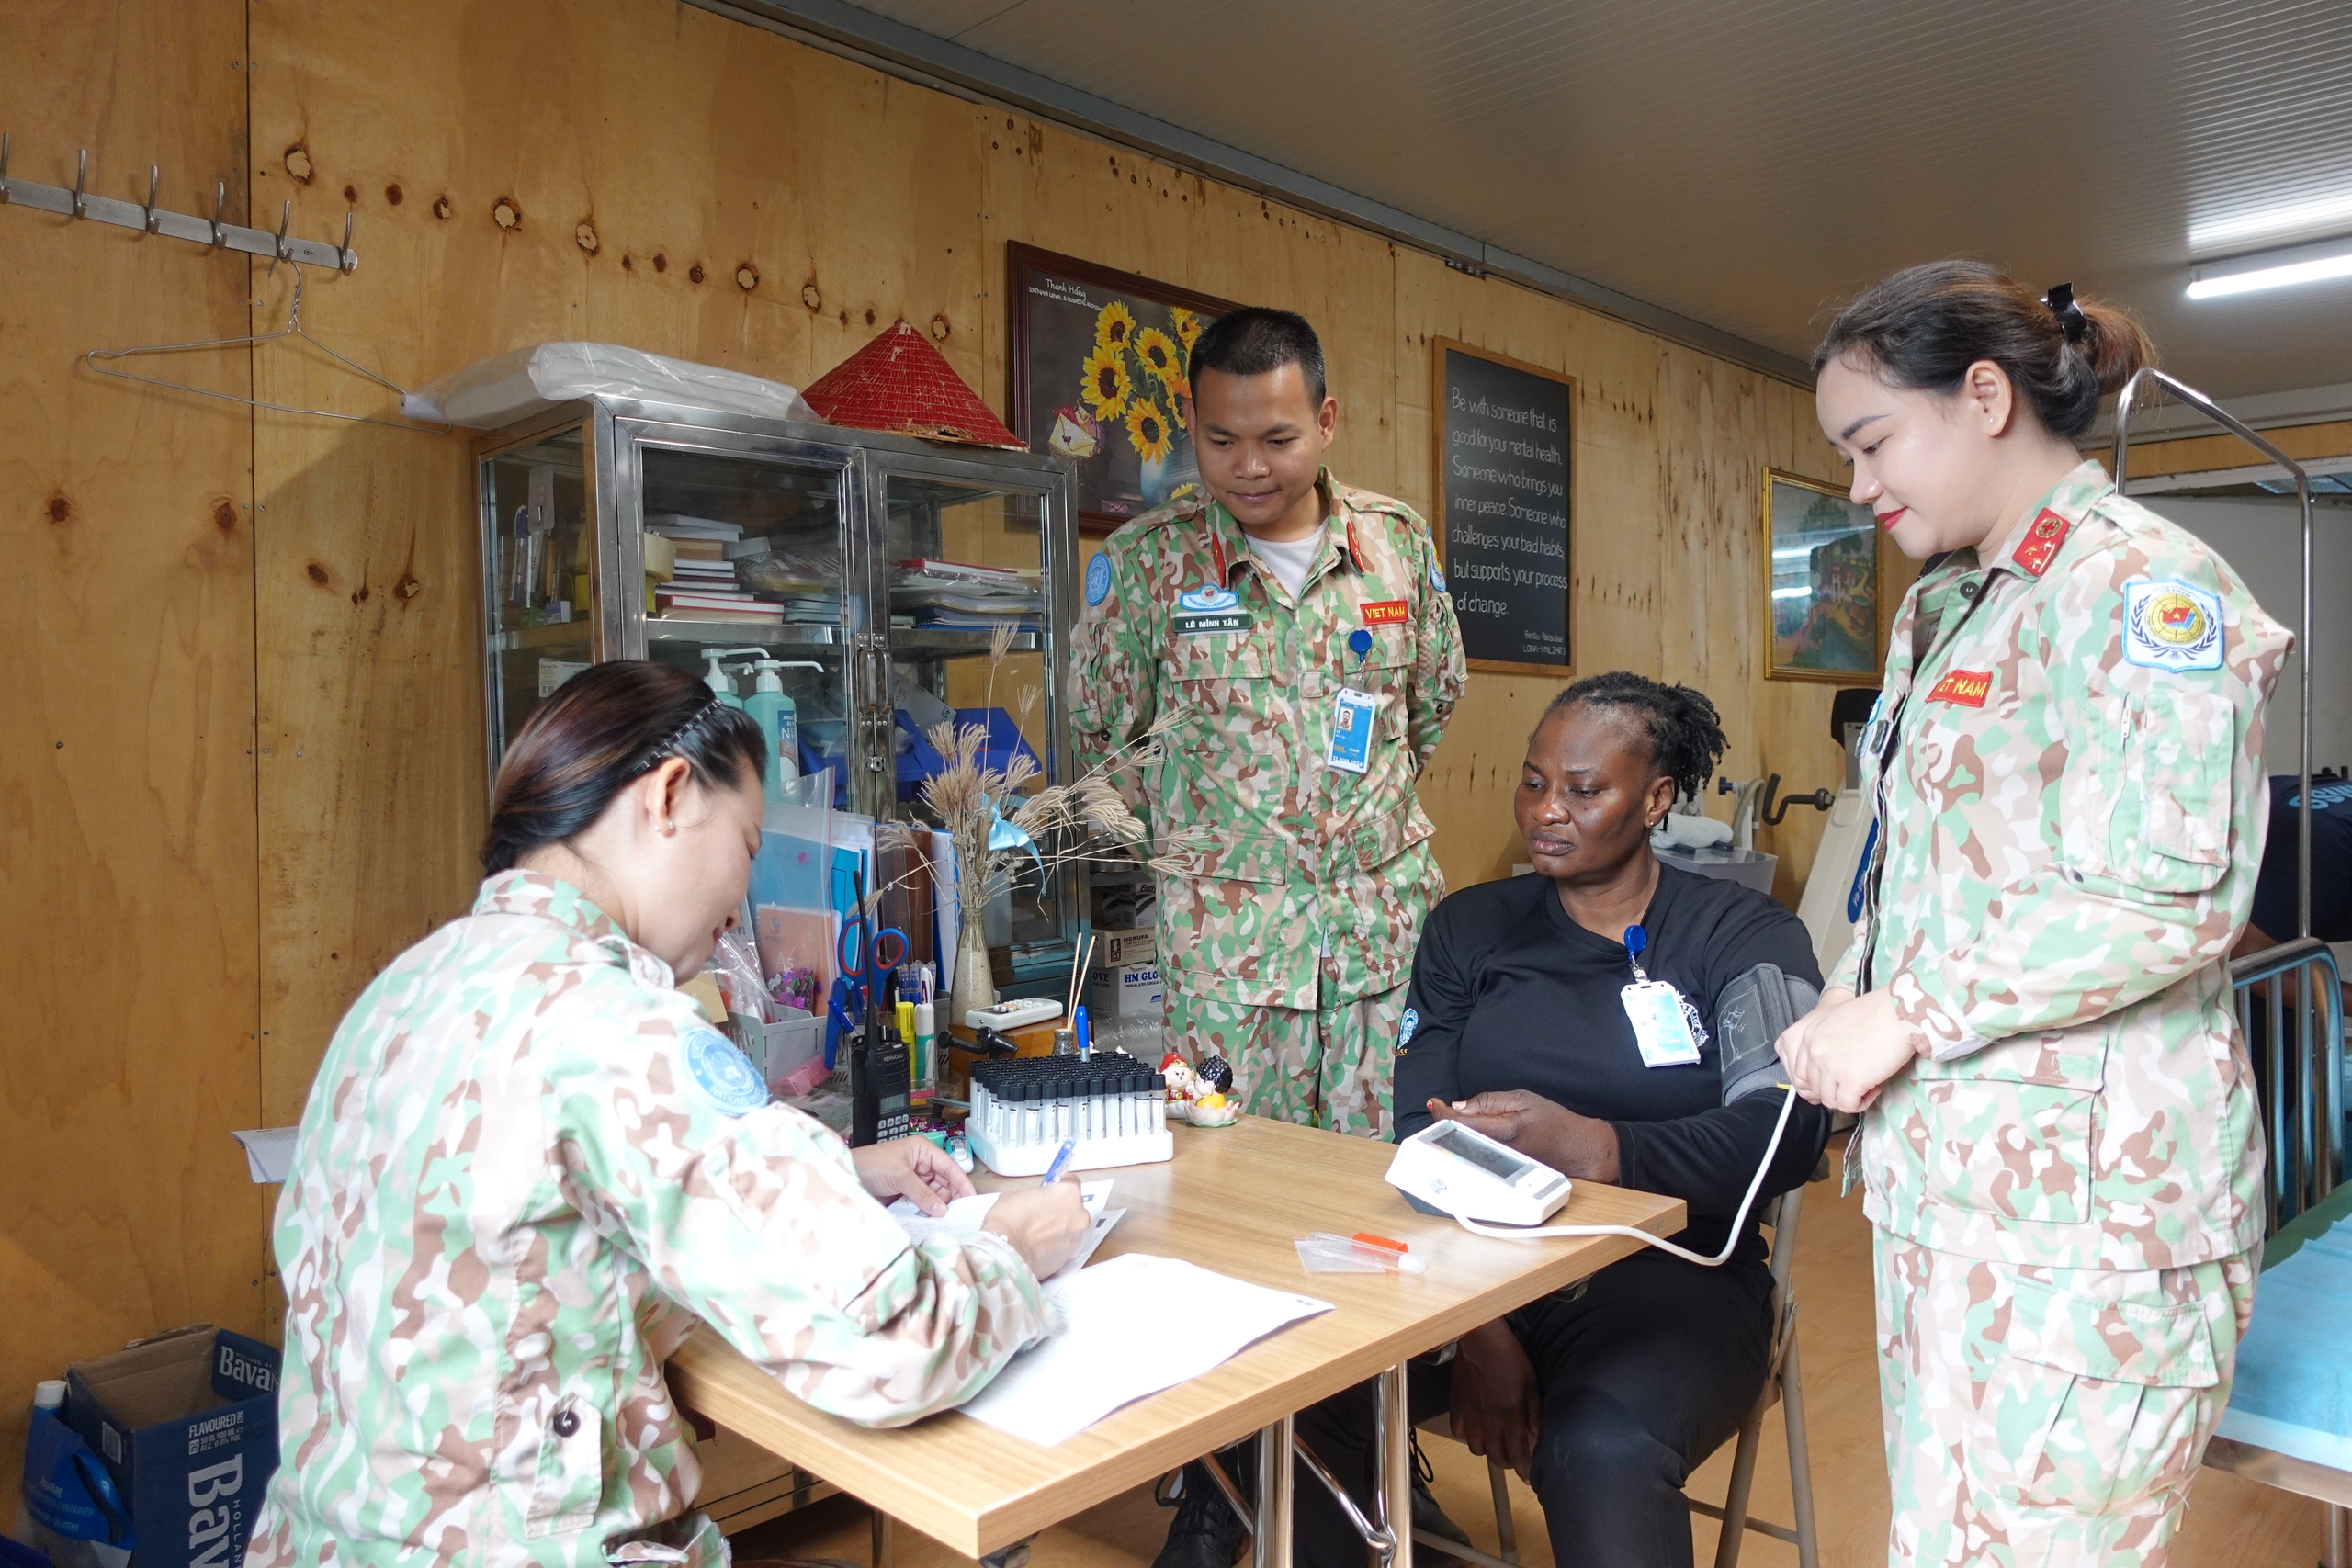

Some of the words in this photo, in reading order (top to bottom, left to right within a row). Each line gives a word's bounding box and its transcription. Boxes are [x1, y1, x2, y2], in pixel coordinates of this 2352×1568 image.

[1046, 278, 1067, 292] Thanh
[1048, 291, 1063, 301] LEVEL
[1452, 387, 1466, 412] Be
[1469, 395, 1489, 416] with
[1490, 404, 1529, 425] someone
[1530, 407, 1546, 430] that
[1548, 418, 1557, 433] is
[1453, 427, 1476, 446] good
[1476, 428, 1487, 447] for
[1488, 436, 1508, 453] your
[1509, 439, 1535, 458] mental
[1535, 442, 1562, 465] health.
[1453, 455, 1498, 483] Someone
[1498, 466, 1521, 489] who
[1521, 468, 1548, 496] brings
[1548, 482, 1563, 497] you
[1454, 495, 1476, 512] inner
[1477, 501, 1507, 516] peace.
[1508, 497, 1548, 525] Someone
[1549, 510, 1566, 529] who
[1452, 522, 1499, 549] challenges
[1500, 536, 1520, 551] your
[1521, 533, 1539, 554] bad
[1453, 558, 1470, 579] but
[1470, 560, 1510, 582] supports
[1512, 569, 1534, 586] your
[1535, 571, 1568, 590] process
[1364, 607, 1386, 619] VIET
[1387, 605, 1407, 617] NAM
[1457, 592, 1468, 611] of
[1468, 590, 1509, 618] change.
[1185, 620, 1196, 629] LÊ
[1222, 617, 1239, 626] TÂN
[1952, 678, 1988, 698] NAM
[1123, 934, 1149, 942] MERUFA
[1092, 971, 1110, 982] OVE
[1125, 973, 1140, 983] HM
[1141, 970, 1159, 981] GLO
[883, 1053, 905, 1062] KENWOOD
[710, 1084, 751, 1107] NATIONS
[188, 1413, 236, 1438] FLAVOURED
[232, 1499, 242, 1568] HOLLAN
